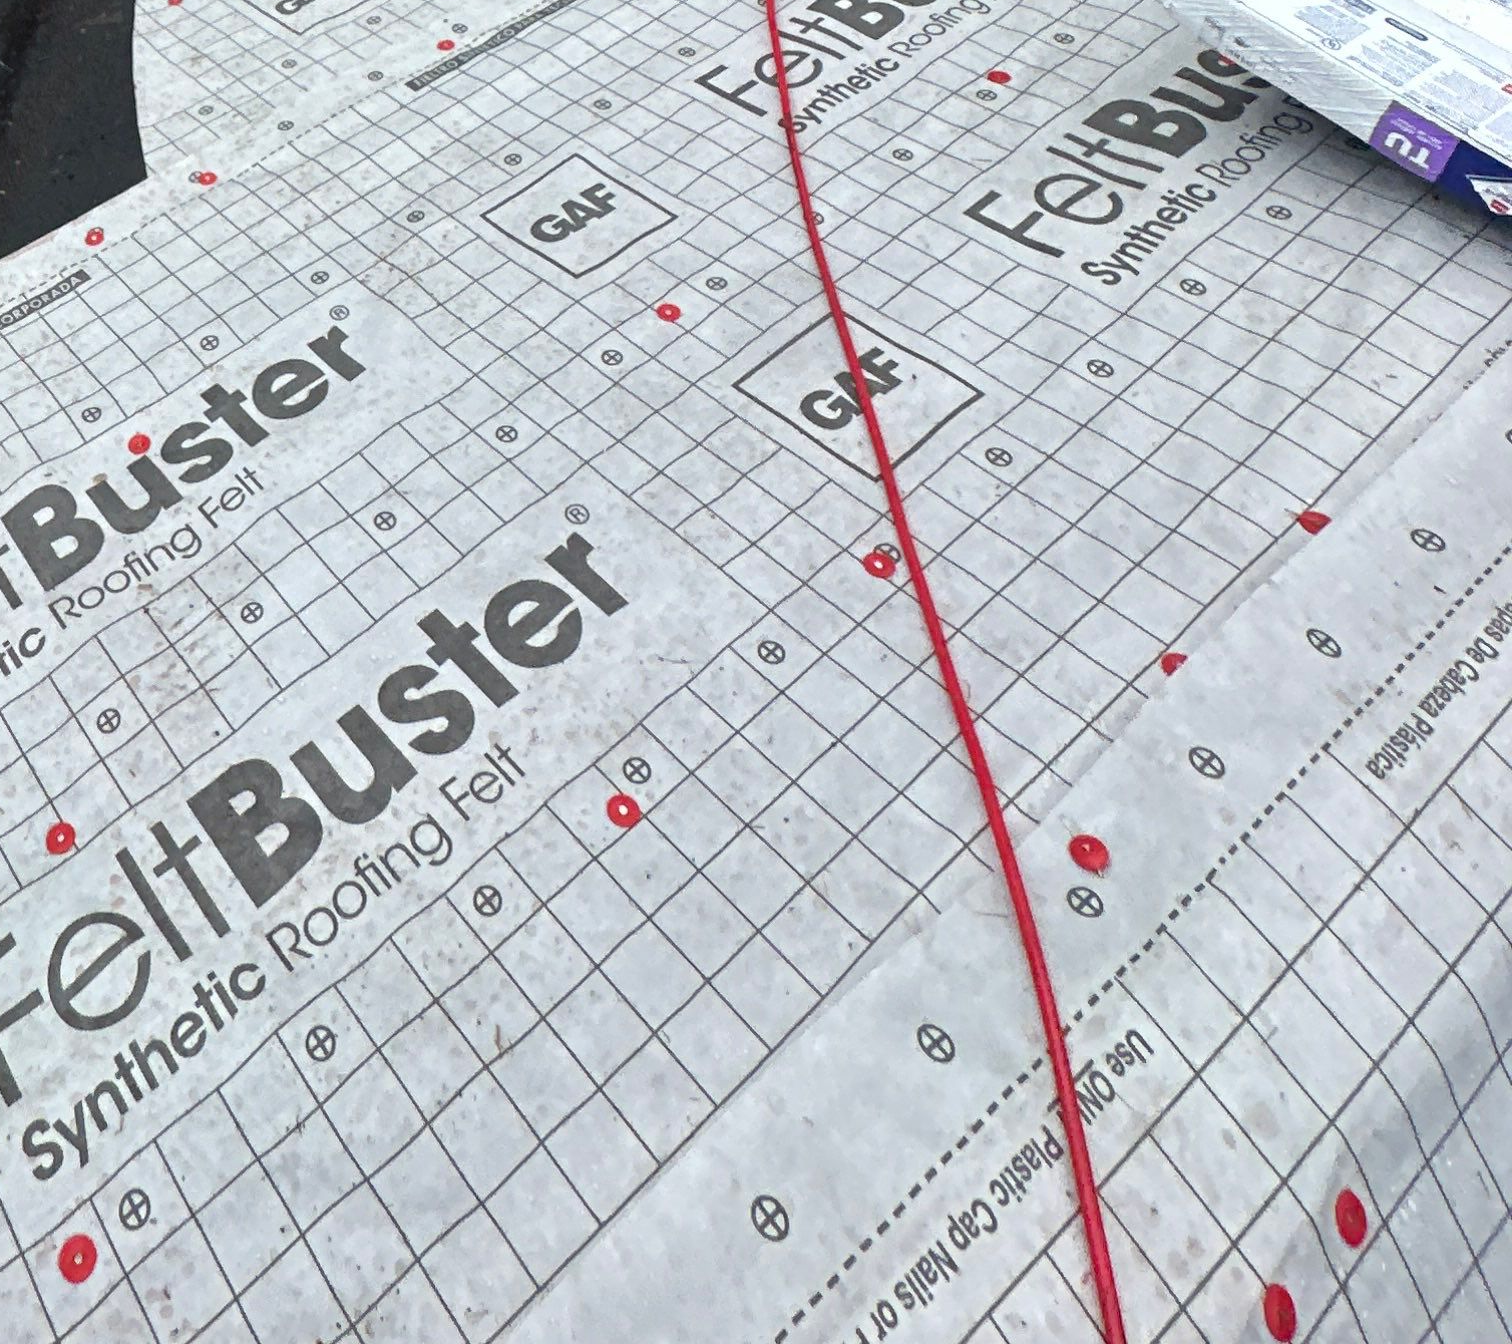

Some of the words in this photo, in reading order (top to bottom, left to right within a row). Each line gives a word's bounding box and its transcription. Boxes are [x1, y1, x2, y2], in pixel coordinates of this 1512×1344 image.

[779, 55, 900, 136] Synthetic
[963, 49, 1272, 257] FeltBus
[1384, 131, 1432, 171] TU
[529, 182, 616, 244] GAF
[1081, 181, 1216, 287] Synthetic
[1196, 114, 1314, 186] Roofing
[799, 347, 903, 430] GAF
[47, 523, 202, 630] Roofing
[197, 465, 264, 530] Felt
[1465, 636, 1500, 664] De
[1418, 659, 1480, 719] Cabeza
[1364, 712, 1434, 780] Plástica
[21, 961, 266, 1181] Synthetic
[265, 814, 454, 972] Roofing
[440, 742, 527, 821] Felt
[1104, 1028, 1156, 1081] Use
[991, 1124, 1064, 1205] Plastic
[951, 1196, 999, 1250] Cap
[893, 1243, 964, 1314] Nails
[876, 1299, 899, 1337] or
